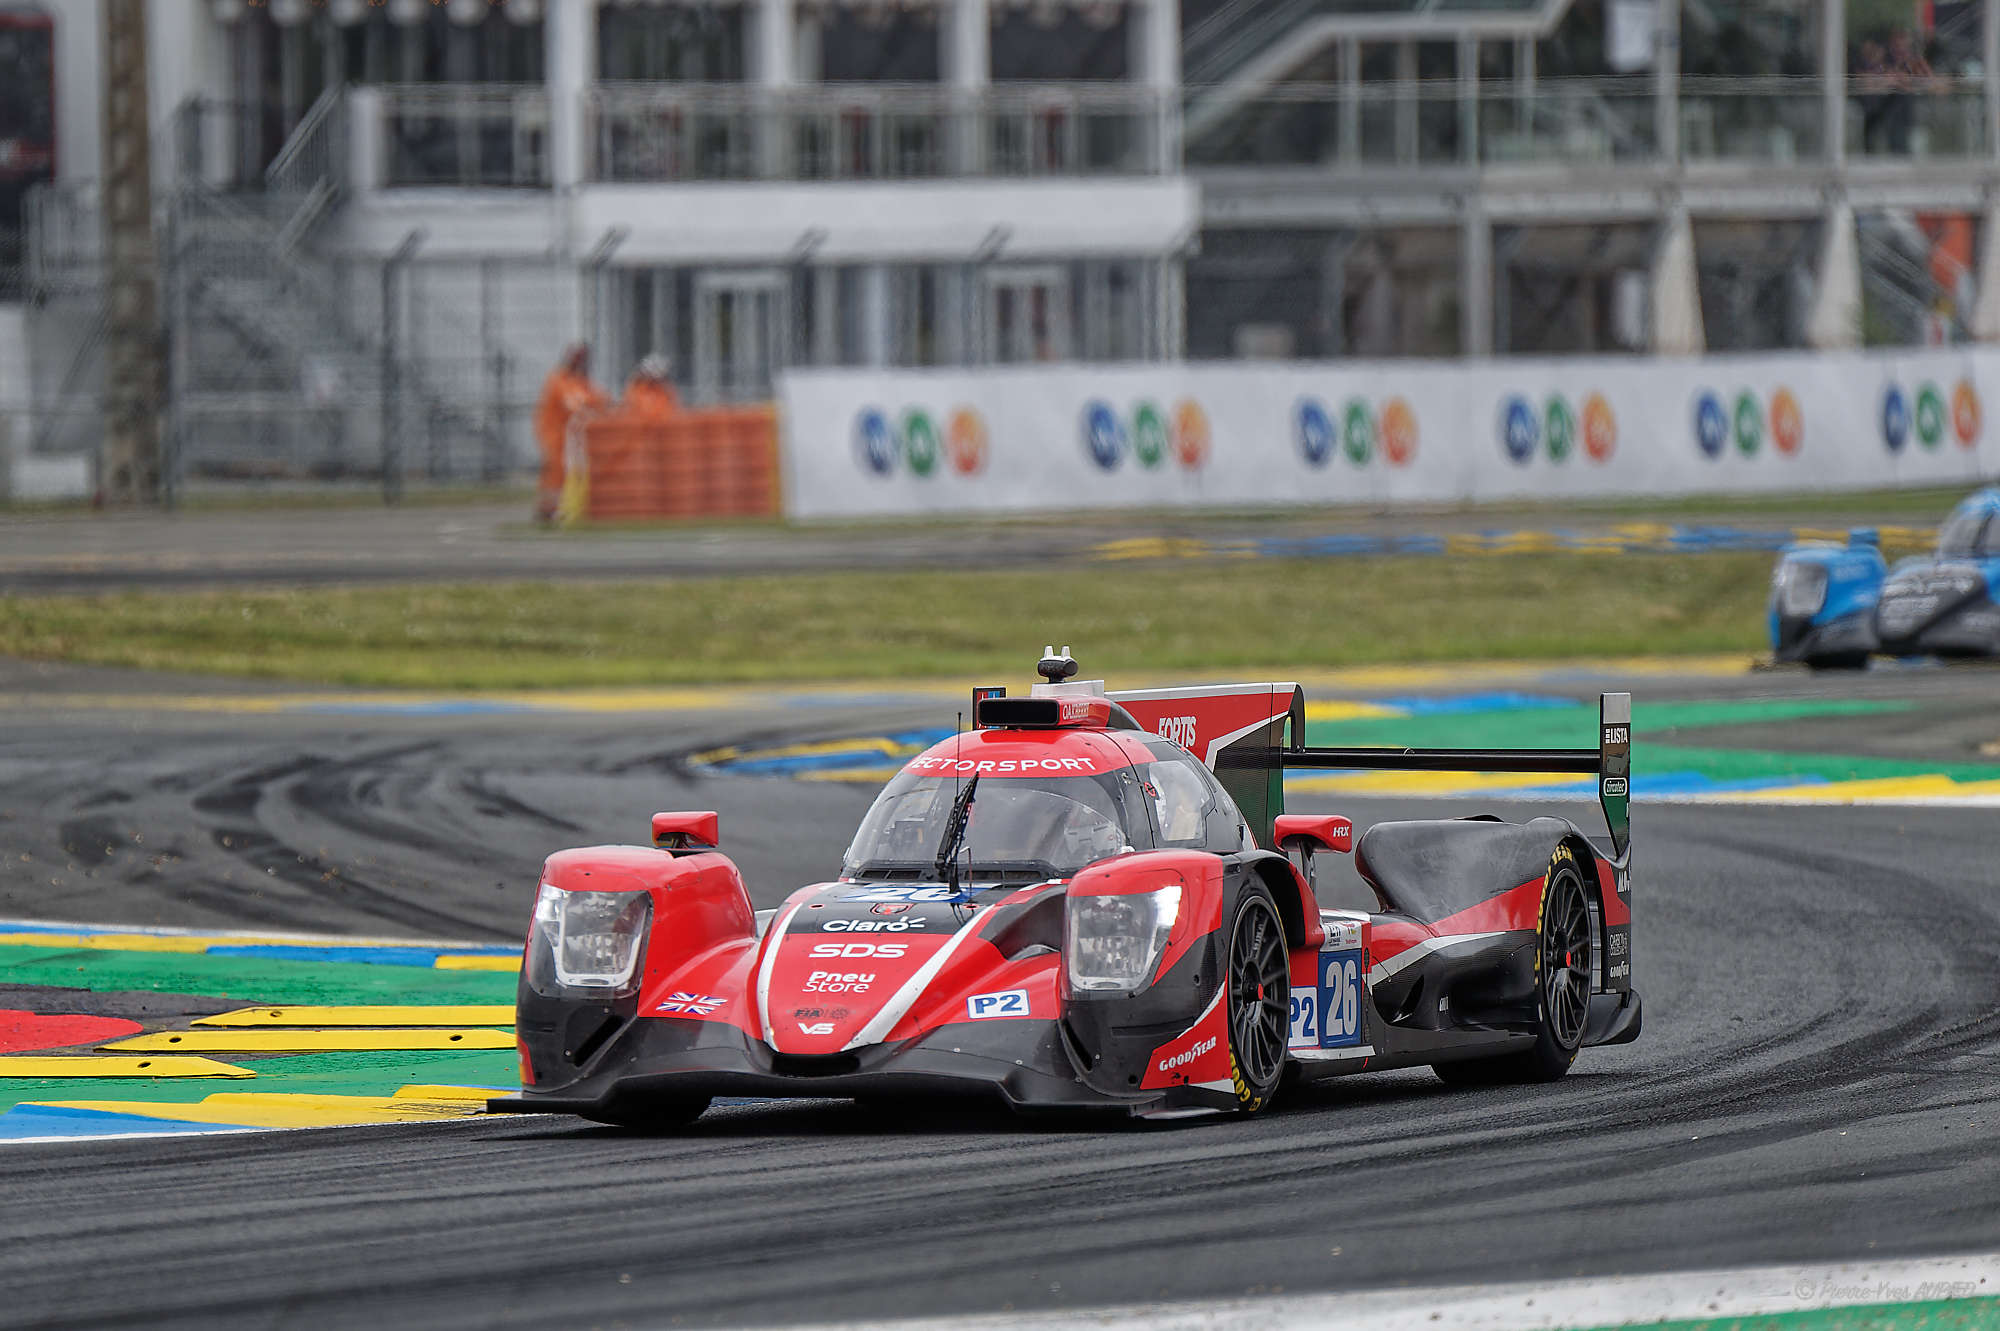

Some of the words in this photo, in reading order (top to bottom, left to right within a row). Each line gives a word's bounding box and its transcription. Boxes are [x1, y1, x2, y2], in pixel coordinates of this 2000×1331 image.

[1158, 716, 1197, 747] FORTIS
[1610, 727, 1628, 744] LISTA
[1333, 826, 1349, 838] HRX
[822, 920, 909, 932] Claro
[809, 943, 908, 958] SDS
[808, 971, 876, 983] Pneu
[802, 981, 870, 993] Store
[974, 994, 1024, 1014] P2
[1325, 959, 1357, 1037] 26
[1288, 996, 1315, 1038] P2
[797, 1022, 836, 1035] VS
[1159, 1036, 1217, 1072] GOODYEAR
